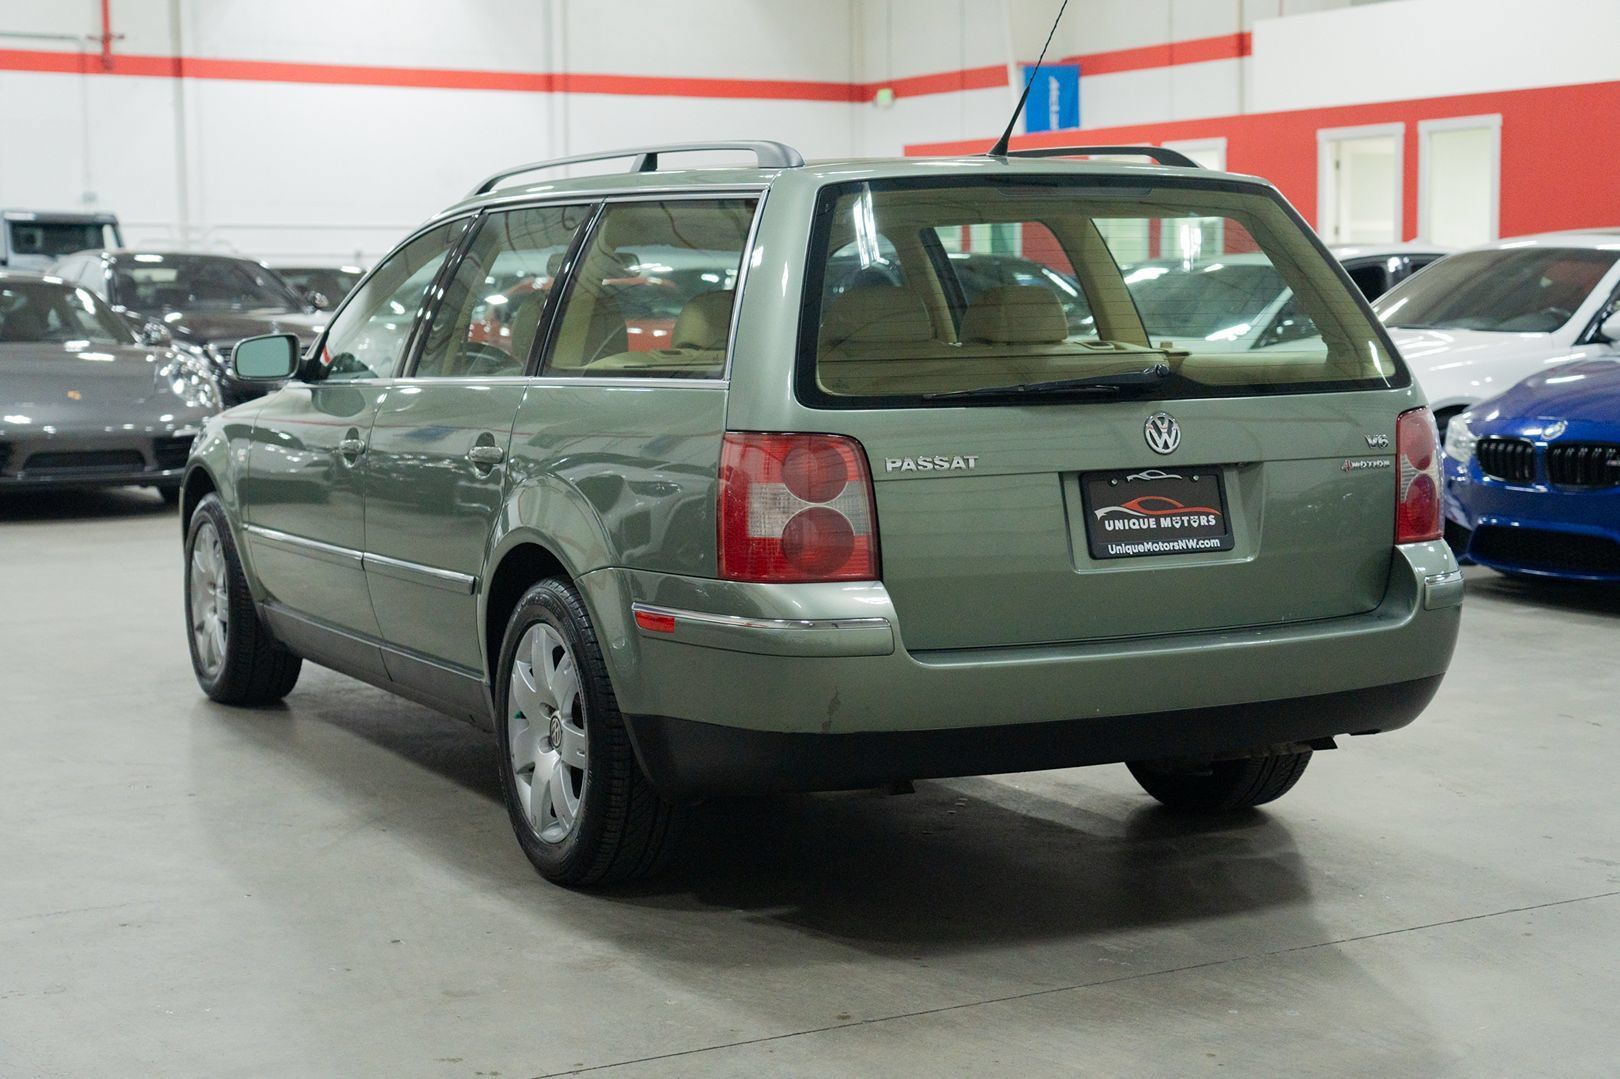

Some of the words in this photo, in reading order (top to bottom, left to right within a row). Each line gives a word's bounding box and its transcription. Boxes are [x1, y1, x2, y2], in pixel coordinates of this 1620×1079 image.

[1144, 411, 1181, 455] VW
[1362, 434, 1389, 449] V6
[885, 455, 979, 472] PASSAT
[1104, 518, 1157, 531] UNIQUE
[1160, 514, 1216, 529] MOTORS
[1108, 538, 1220, 555] UniqueMotorsNW.com
